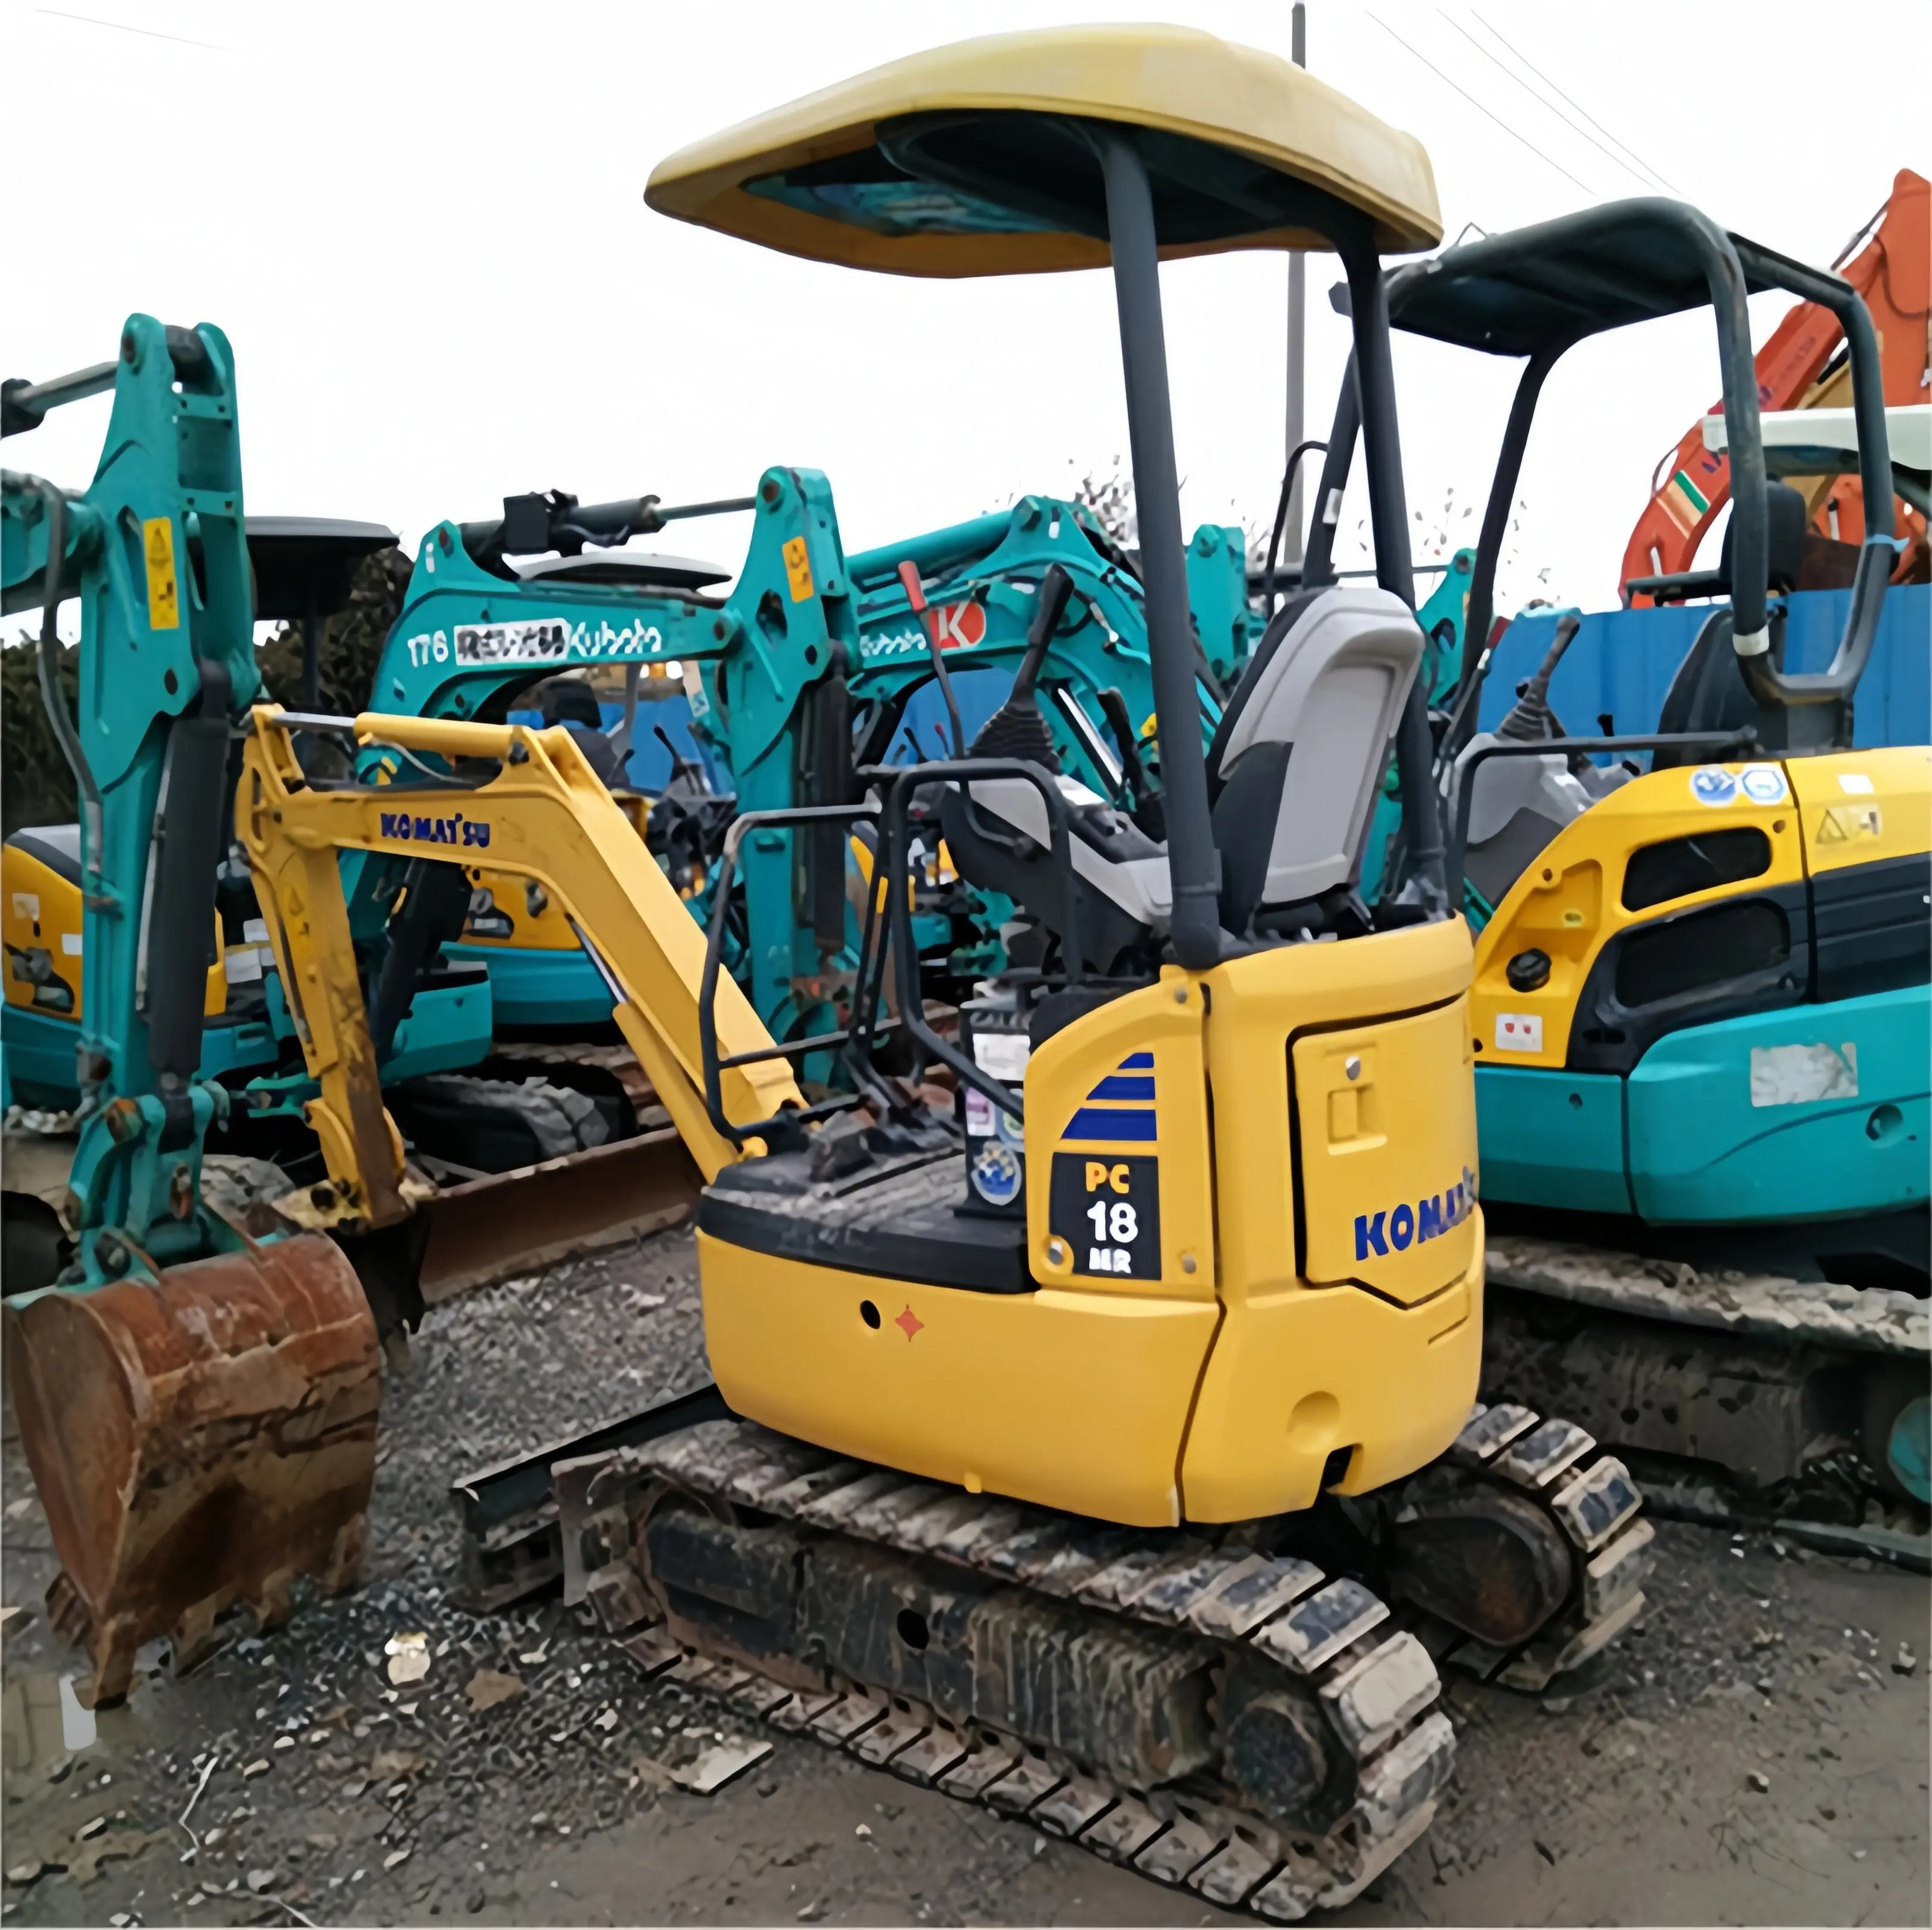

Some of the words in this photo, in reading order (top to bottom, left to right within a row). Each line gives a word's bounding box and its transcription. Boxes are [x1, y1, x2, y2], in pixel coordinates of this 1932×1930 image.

[380, 812, 490, 848] KOMATSU
[1085, 1162, 1130, 1194] PC
[1087, 1201, 1138, 1243] 18
